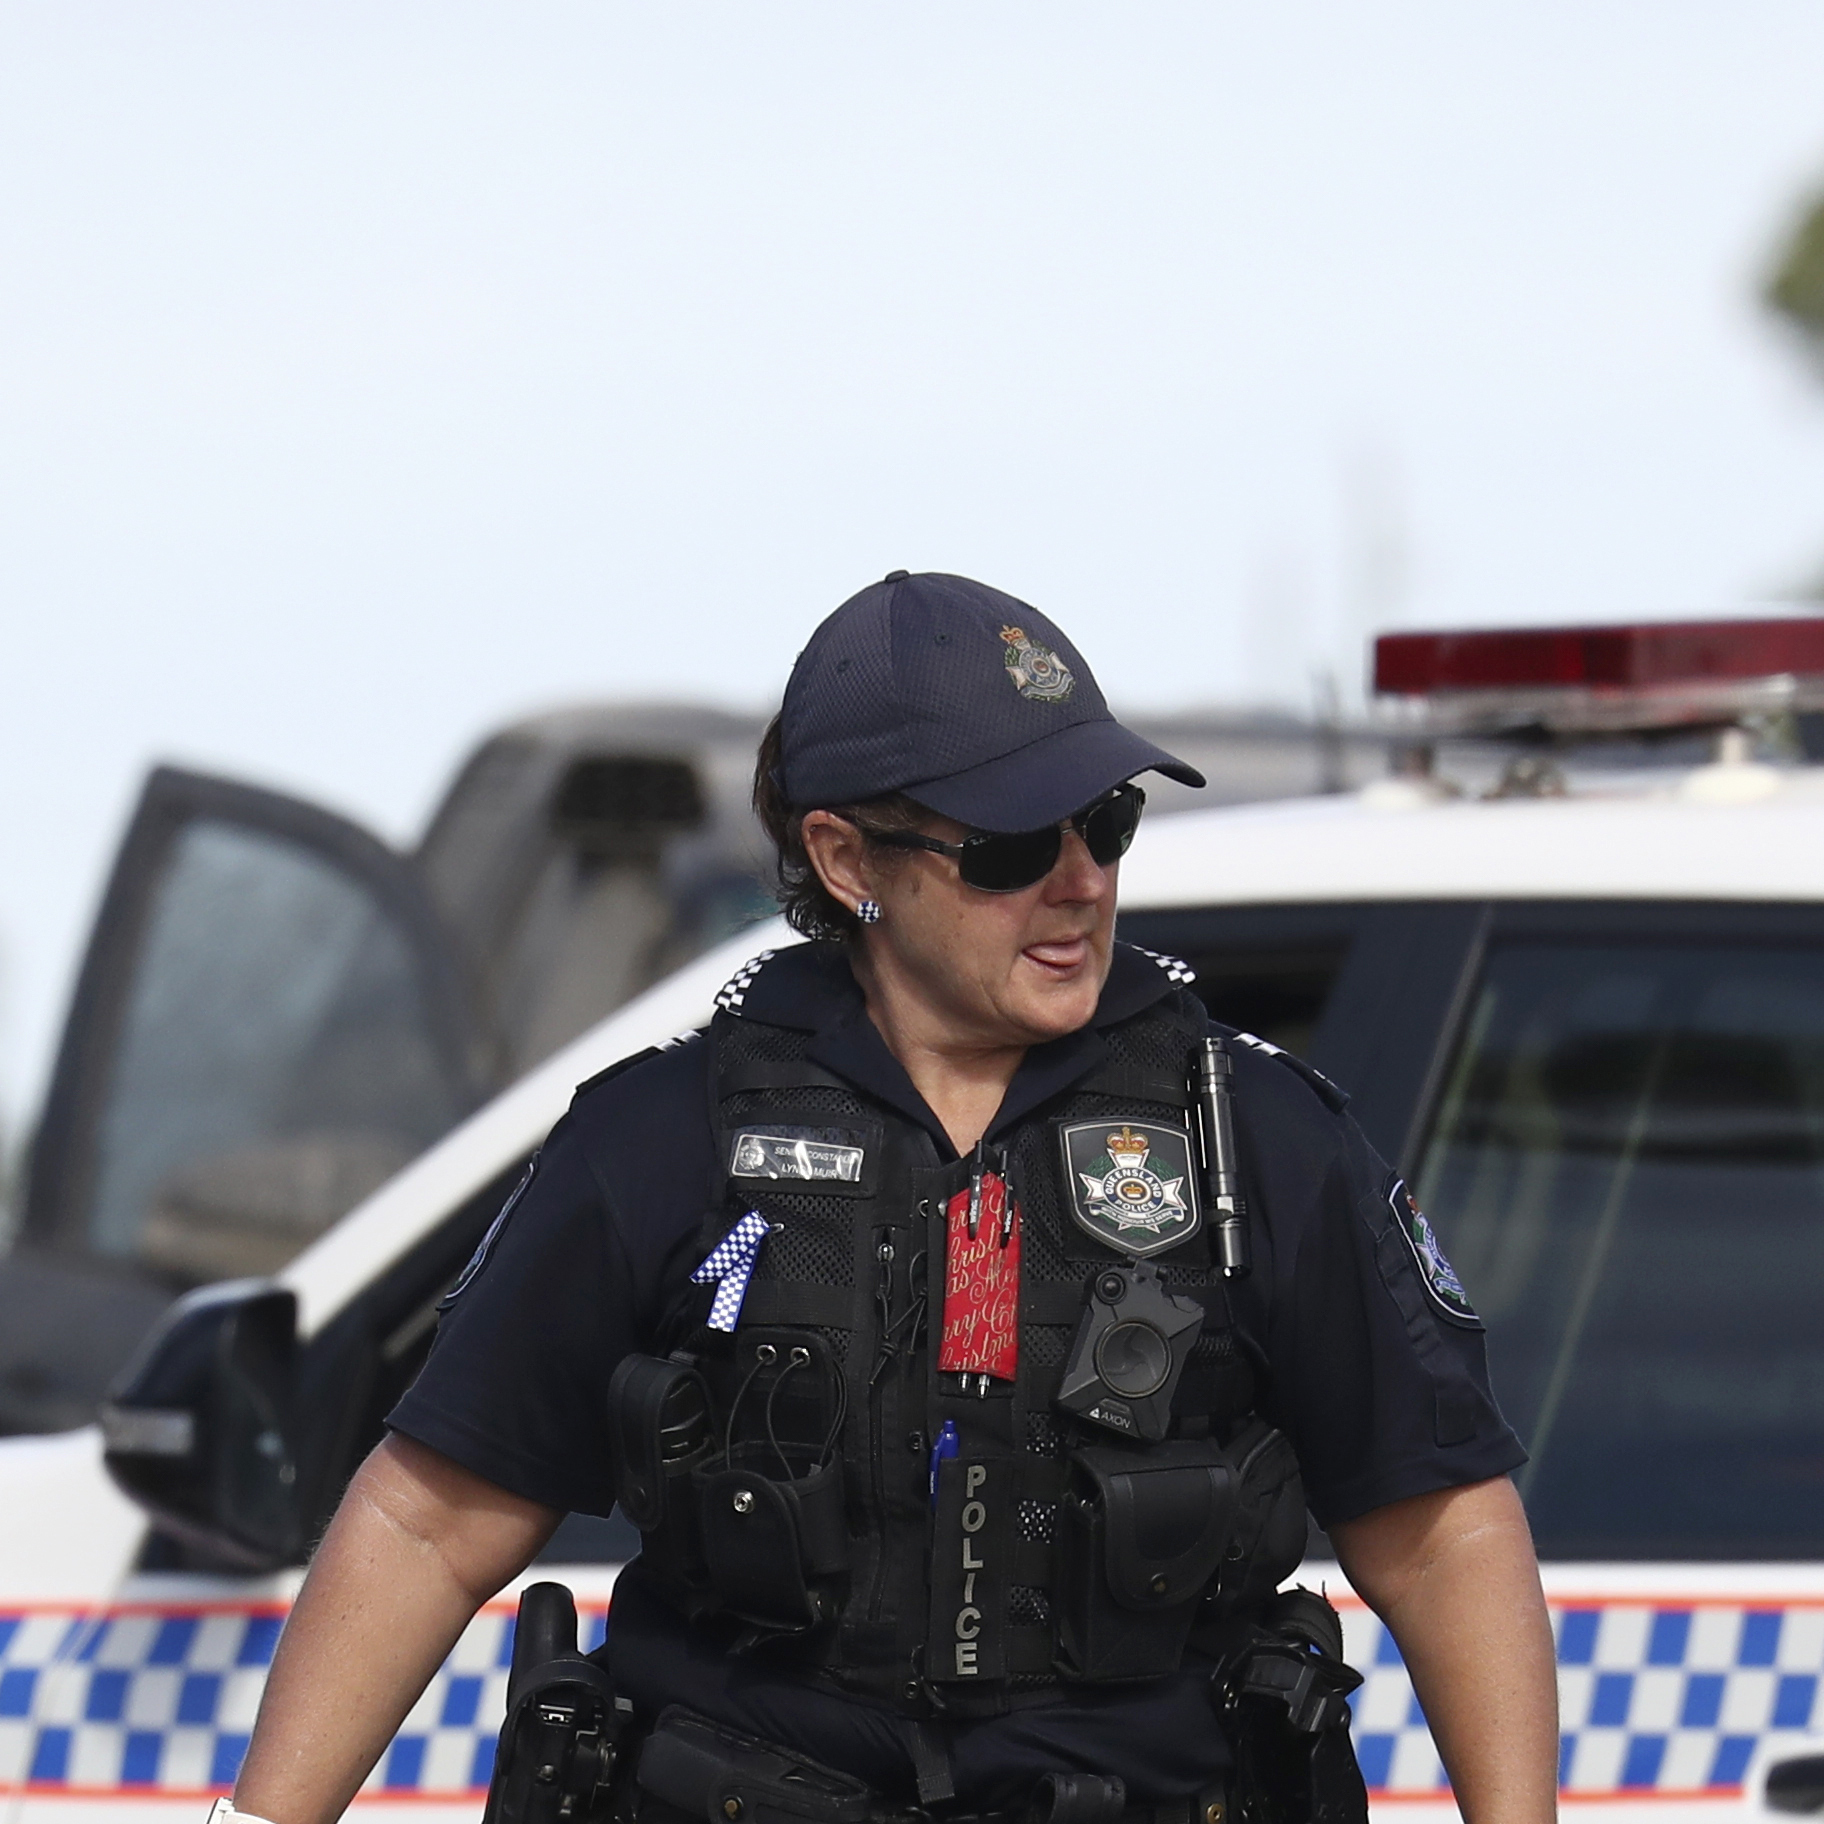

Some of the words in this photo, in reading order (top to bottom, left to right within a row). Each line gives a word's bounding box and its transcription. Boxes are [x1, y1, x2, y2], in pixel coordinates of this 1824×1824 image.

[774, 1146, 805, 1159] SEN
[1104, 1168, 1162, 1198] QUEENSLAND
[1114, 1199, 1157, 1212] POLICE
[1100, 1411, 1131, 1429] AXON
[955, 1465, 987, 1675] POLICE
